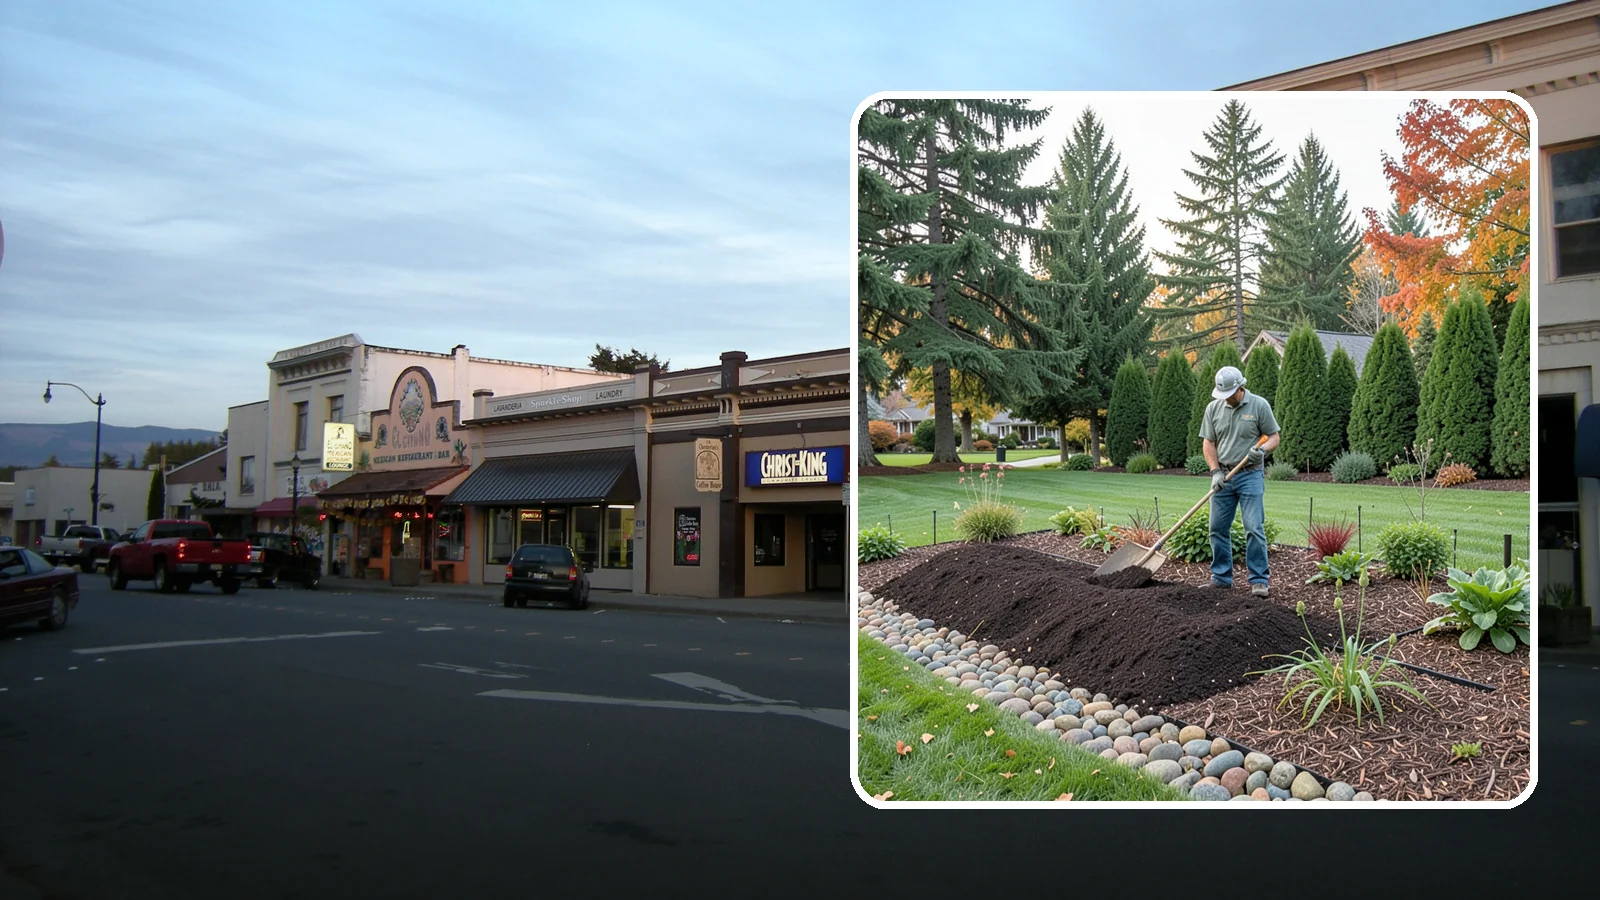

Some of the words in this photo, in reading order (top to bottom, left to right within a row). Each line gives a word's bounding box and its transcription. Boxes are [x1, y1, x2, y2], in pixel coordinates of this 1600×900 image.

[530, 396, 561, 408] Sparkle
[561, 394, 583, 404] Shop
[596, 389, 623, 400] LAUNDRY
[493, 402, 522, 412] LAVANDERIA
[392, 426, 402, 448] EL
[403, 422, 431, 448] GITANO
[333, 440, 352, 450] GITANO
[374, 455, 396, 464] MEXICAN
[397, 451, 433, 462] RESTAURANT
[437, 450, 450, 459] BAR
[761, 452, 797, 478] CHRIST
[799, 450, 827, 476] KING
